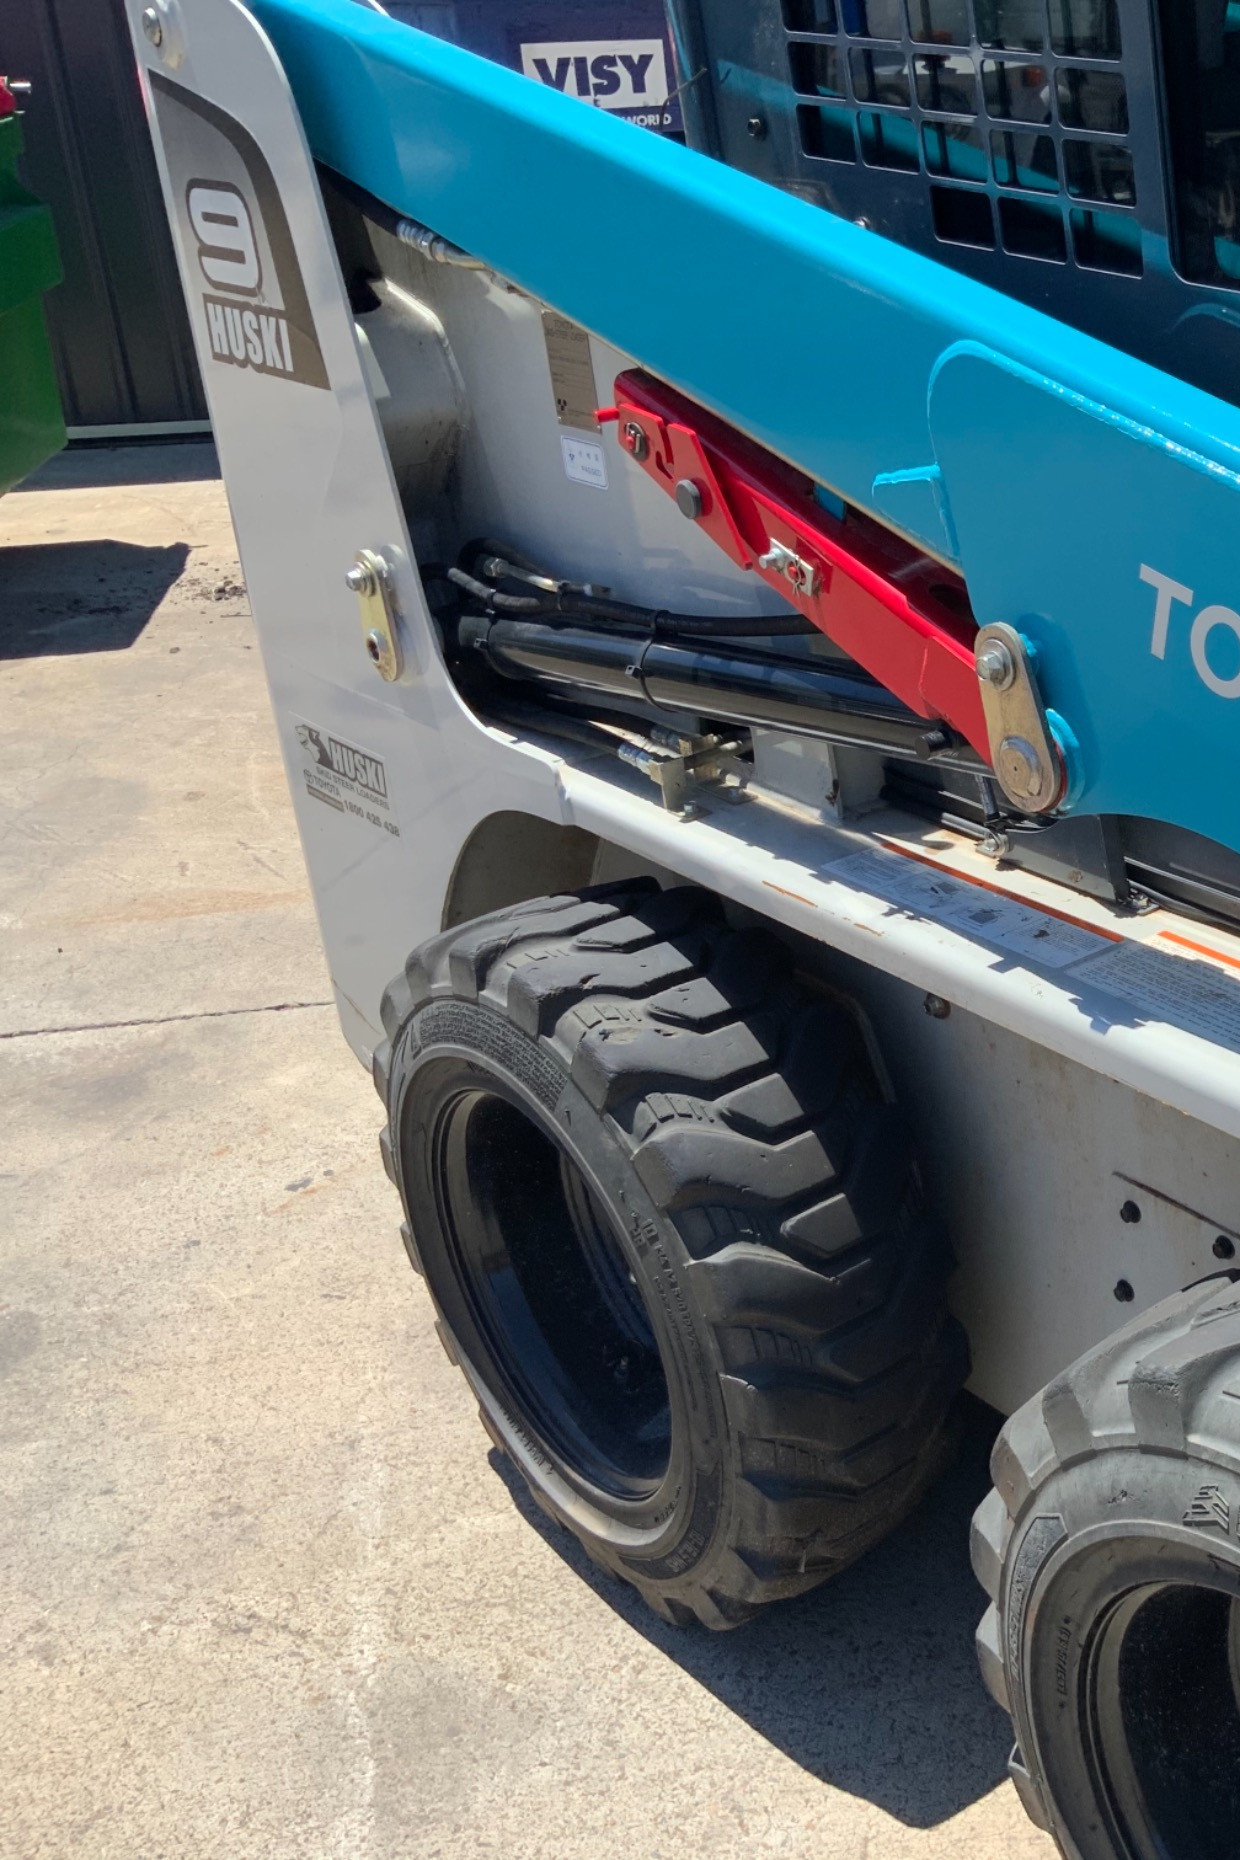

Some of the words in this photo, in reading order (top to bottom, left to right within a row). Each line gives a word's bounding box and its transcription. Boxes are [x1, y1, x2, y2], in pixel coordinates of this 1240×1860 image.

[532, 54, 654, 97] VISY
[188, 185, 261, 291] 9
[205, 302, 294, 372] HUSKI
[328, 737, 388, 799] HUSKI
